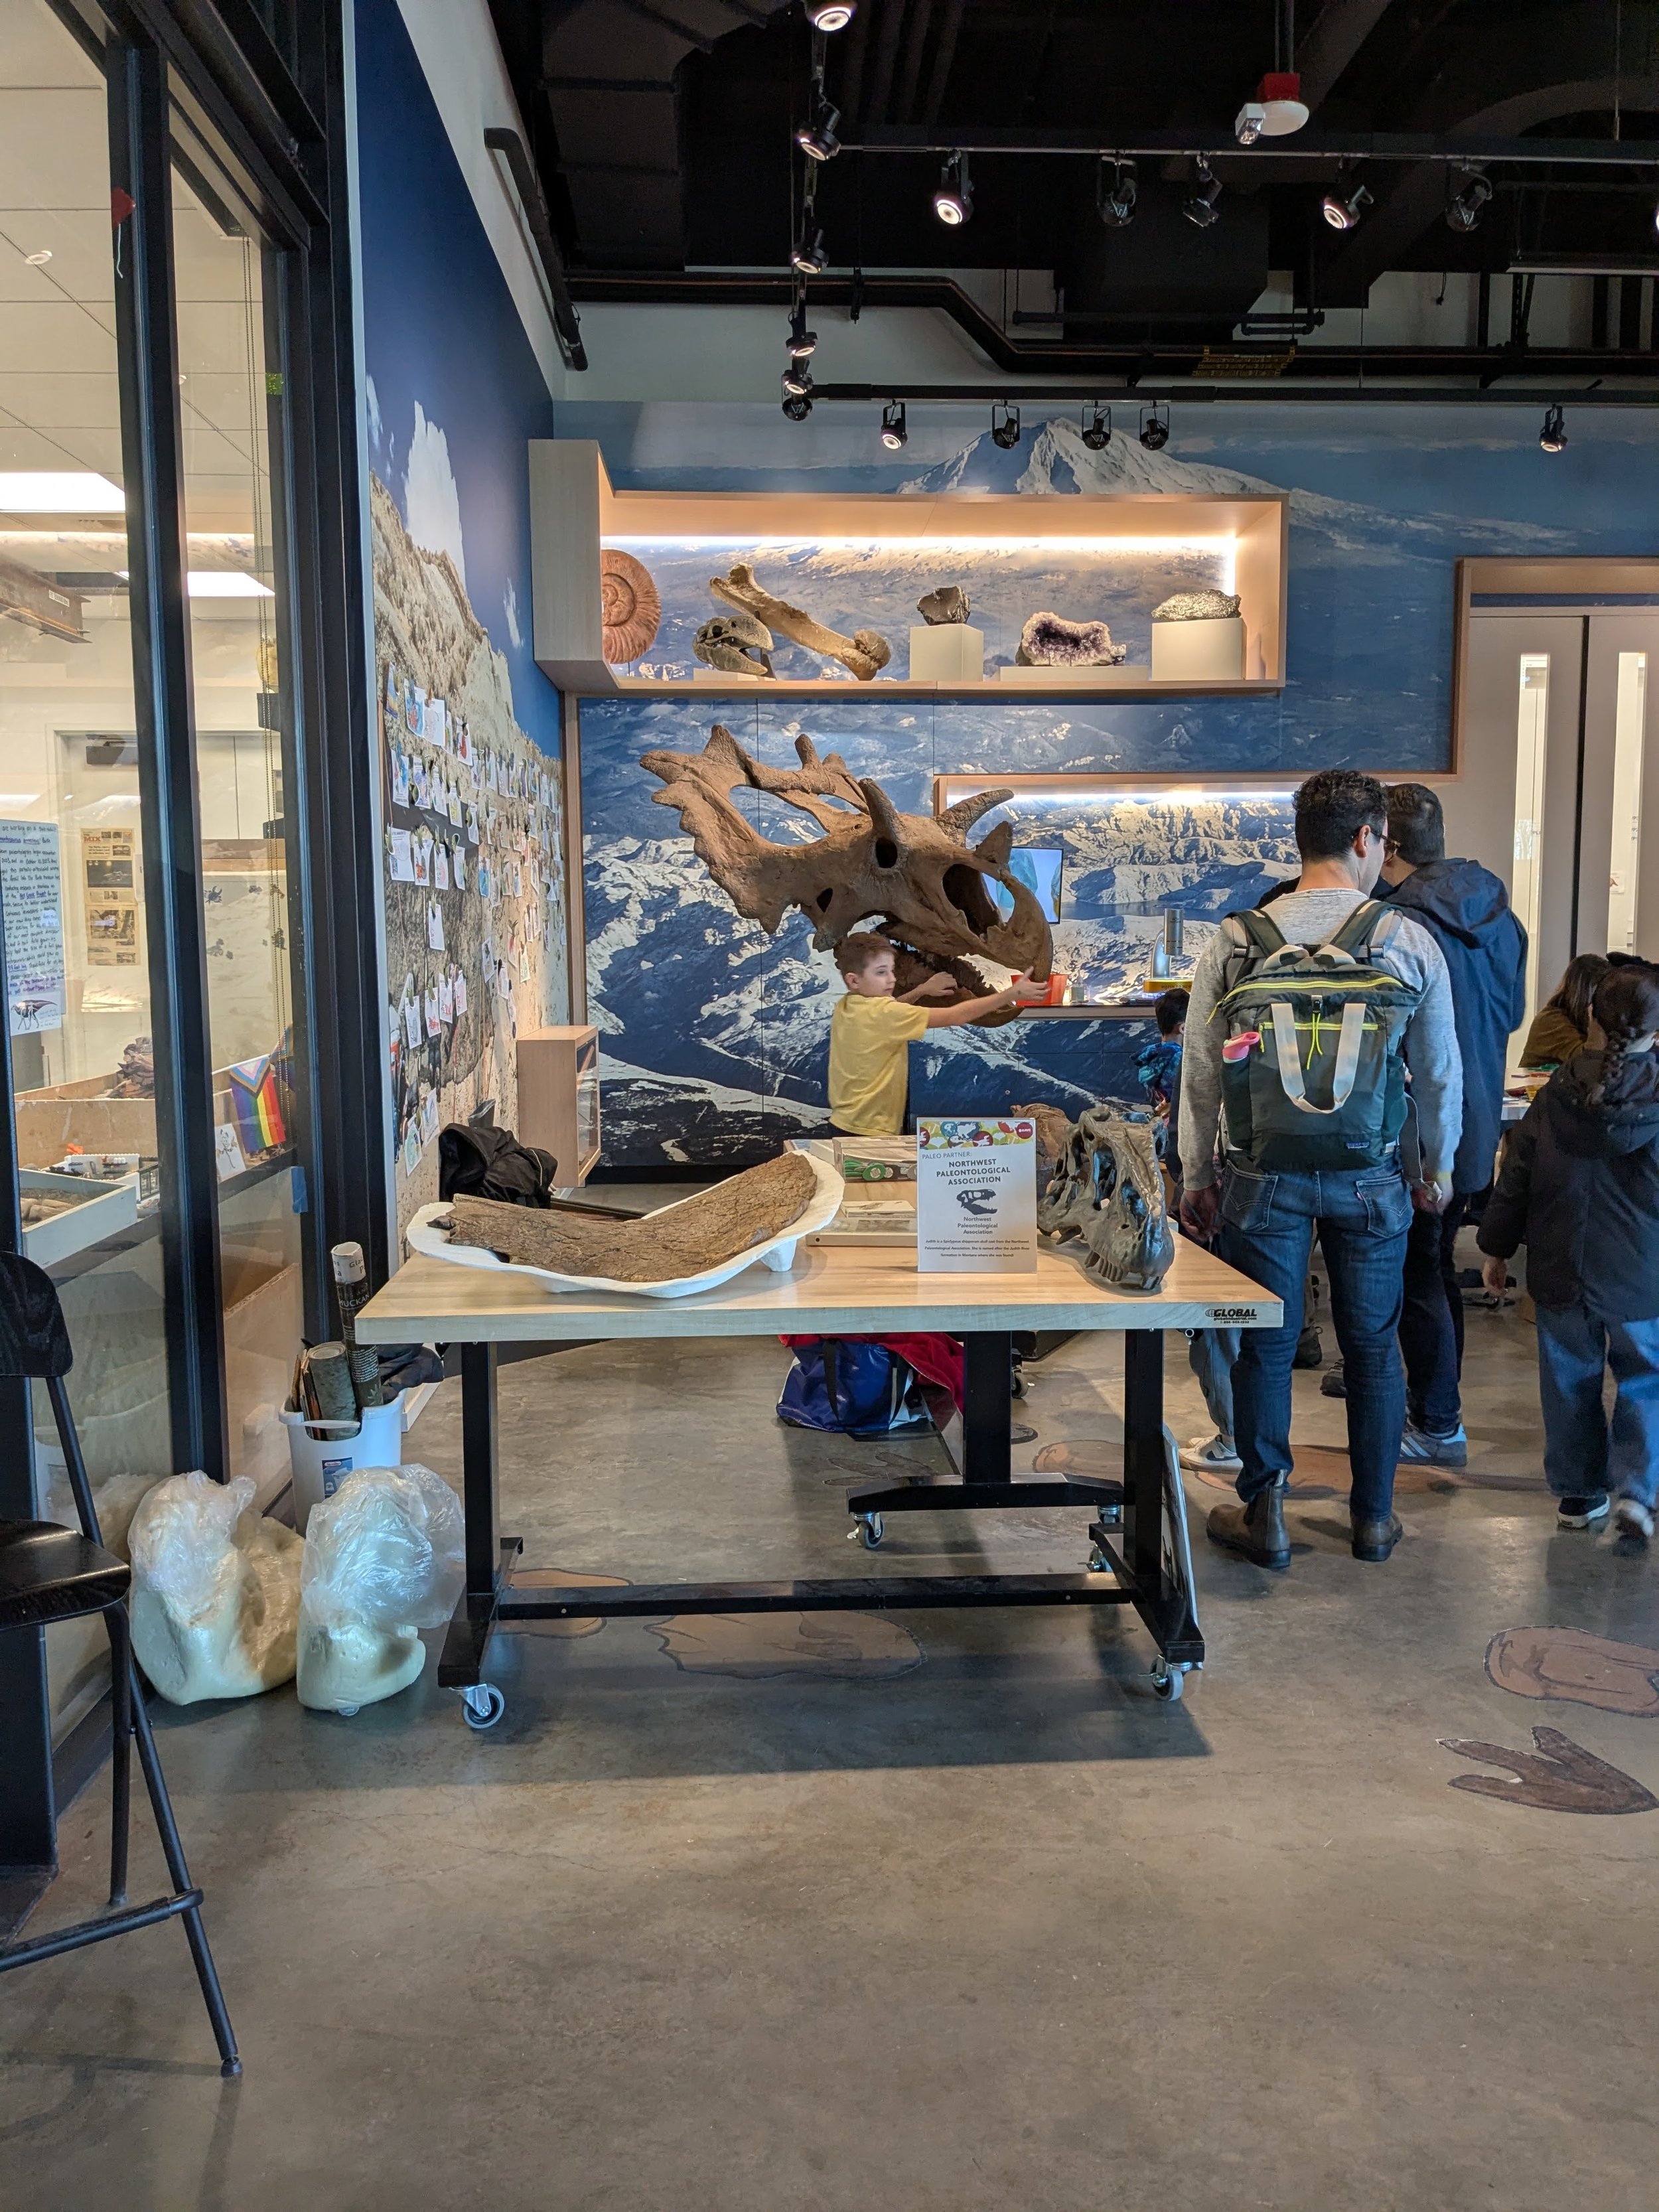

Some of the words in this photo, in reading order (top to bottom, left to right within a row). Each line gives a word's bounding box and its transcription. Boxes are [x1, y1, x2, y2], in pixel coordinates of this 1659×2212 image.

[948, 1159, 997, 1168] NORTHWEST
[936, 1166, 1011, 1177] PALEONTOLOGICAL
[948, 1176, 1001, 1186] ASSOCIATION
[1214, 1308, 1258, 1317] GLOBAL
